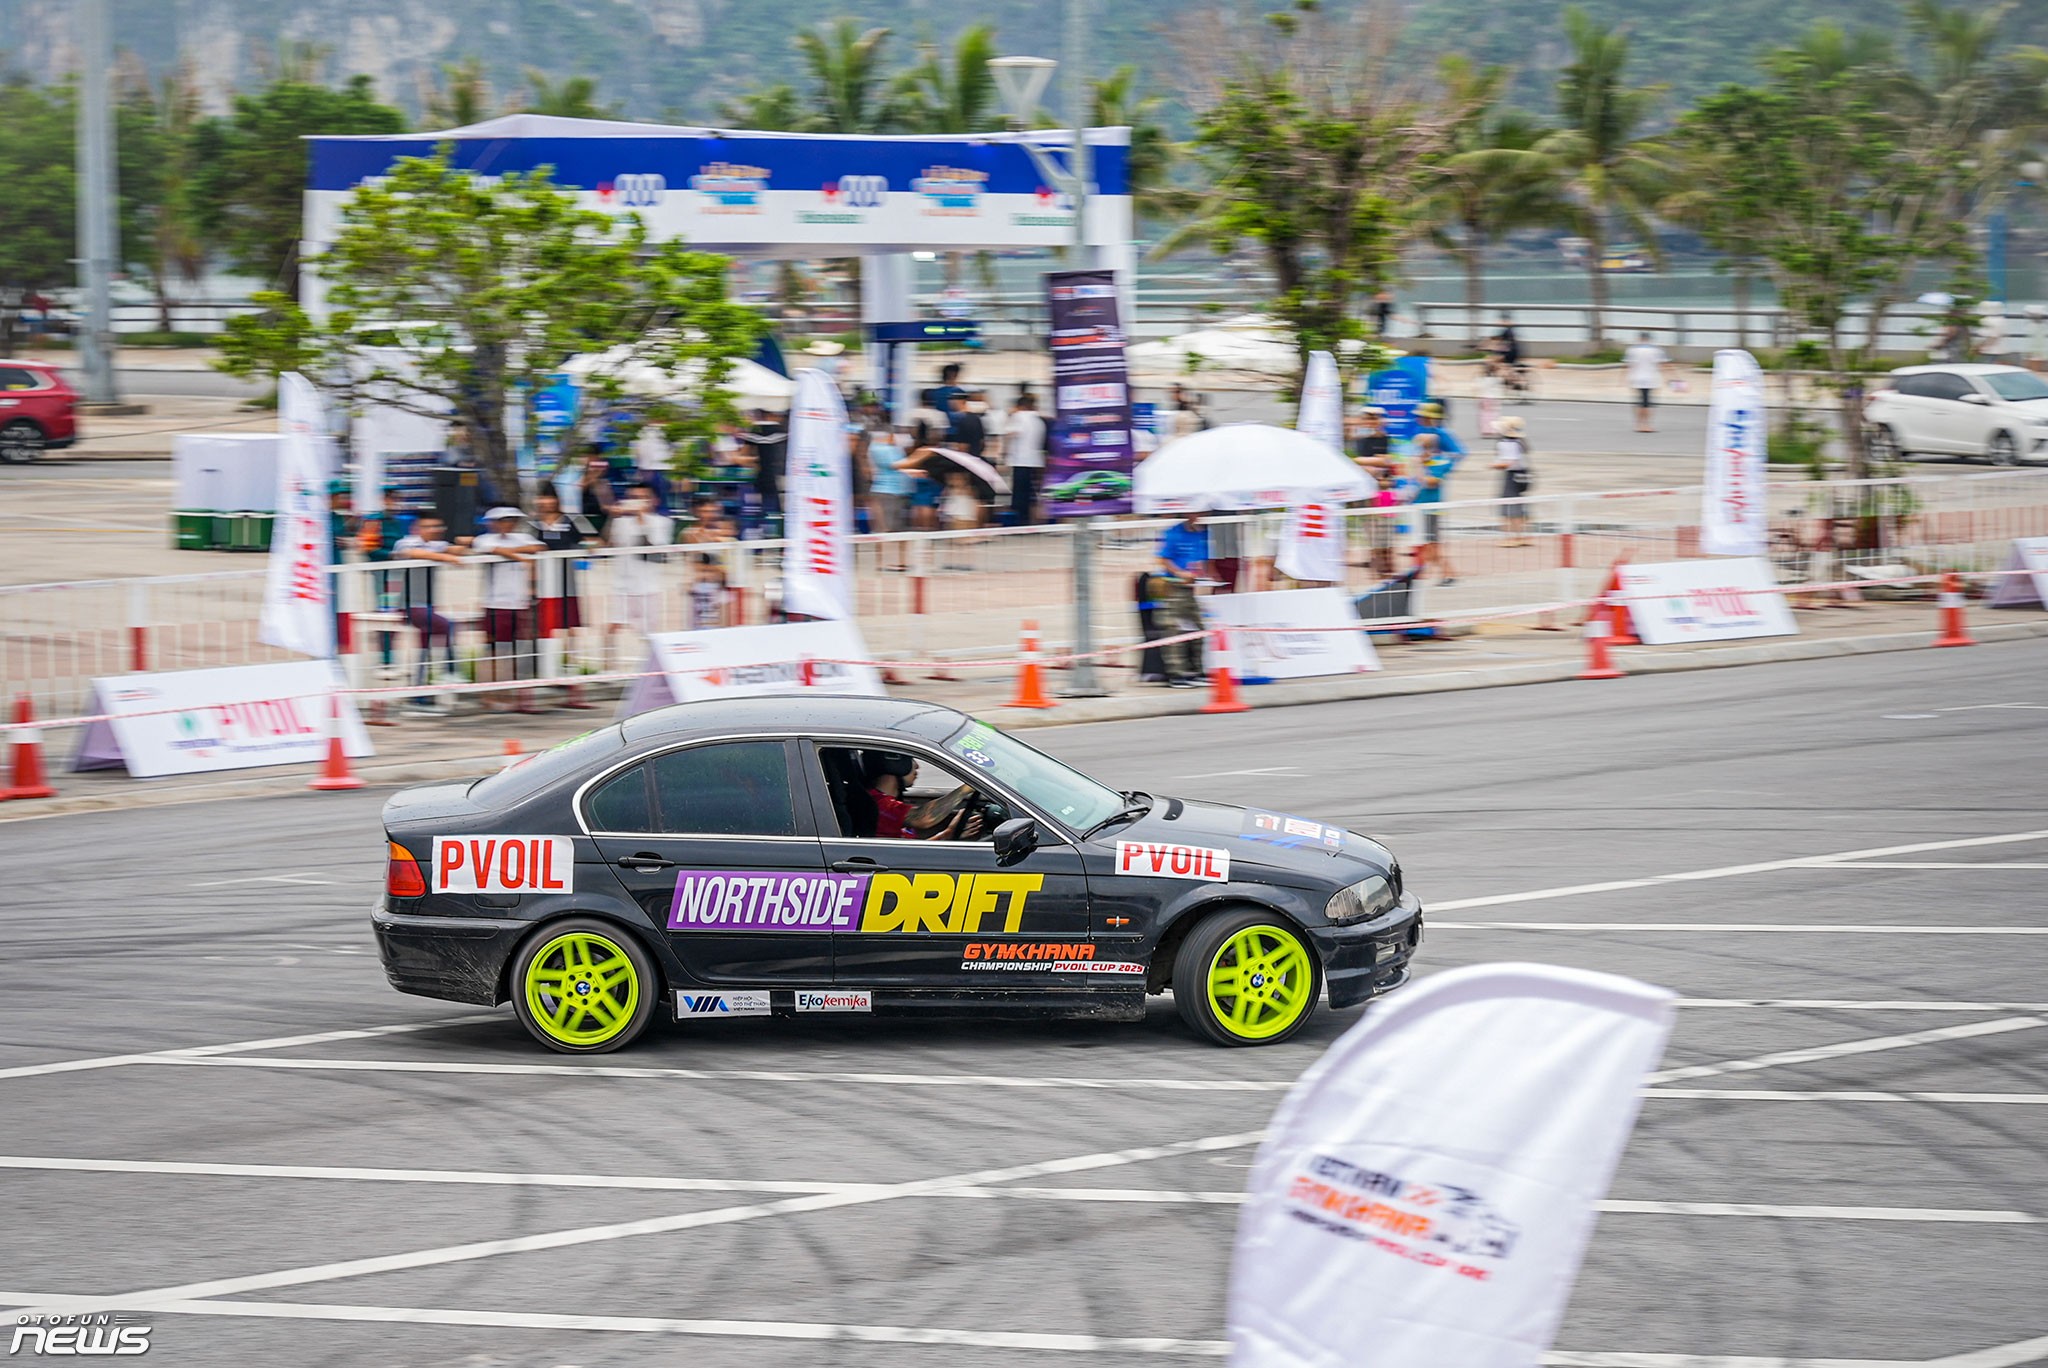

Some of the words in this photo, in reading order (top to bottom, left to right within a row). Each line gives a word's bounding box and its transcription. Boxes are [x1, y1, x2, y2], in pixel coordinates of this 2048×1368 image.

[440, 839, 564, 889] PVOIL
[1122, 843, 1222, 878] PVOIL
[676, 876, 859, 926] NORTHSIDE
[860, 873, 1045, 932] DRIFT
[963, 943, 1096, 960] GYMKHANA
[961, 961, 1052, 971] CHAMPIONSHIP
[1054, 963, 1089, 971] PVOIL
[1091, 963, 1116, 972] CUP
[1118, 964, 1144, 973] 2025
[799, 994, 868, 1009] Ekokemika
